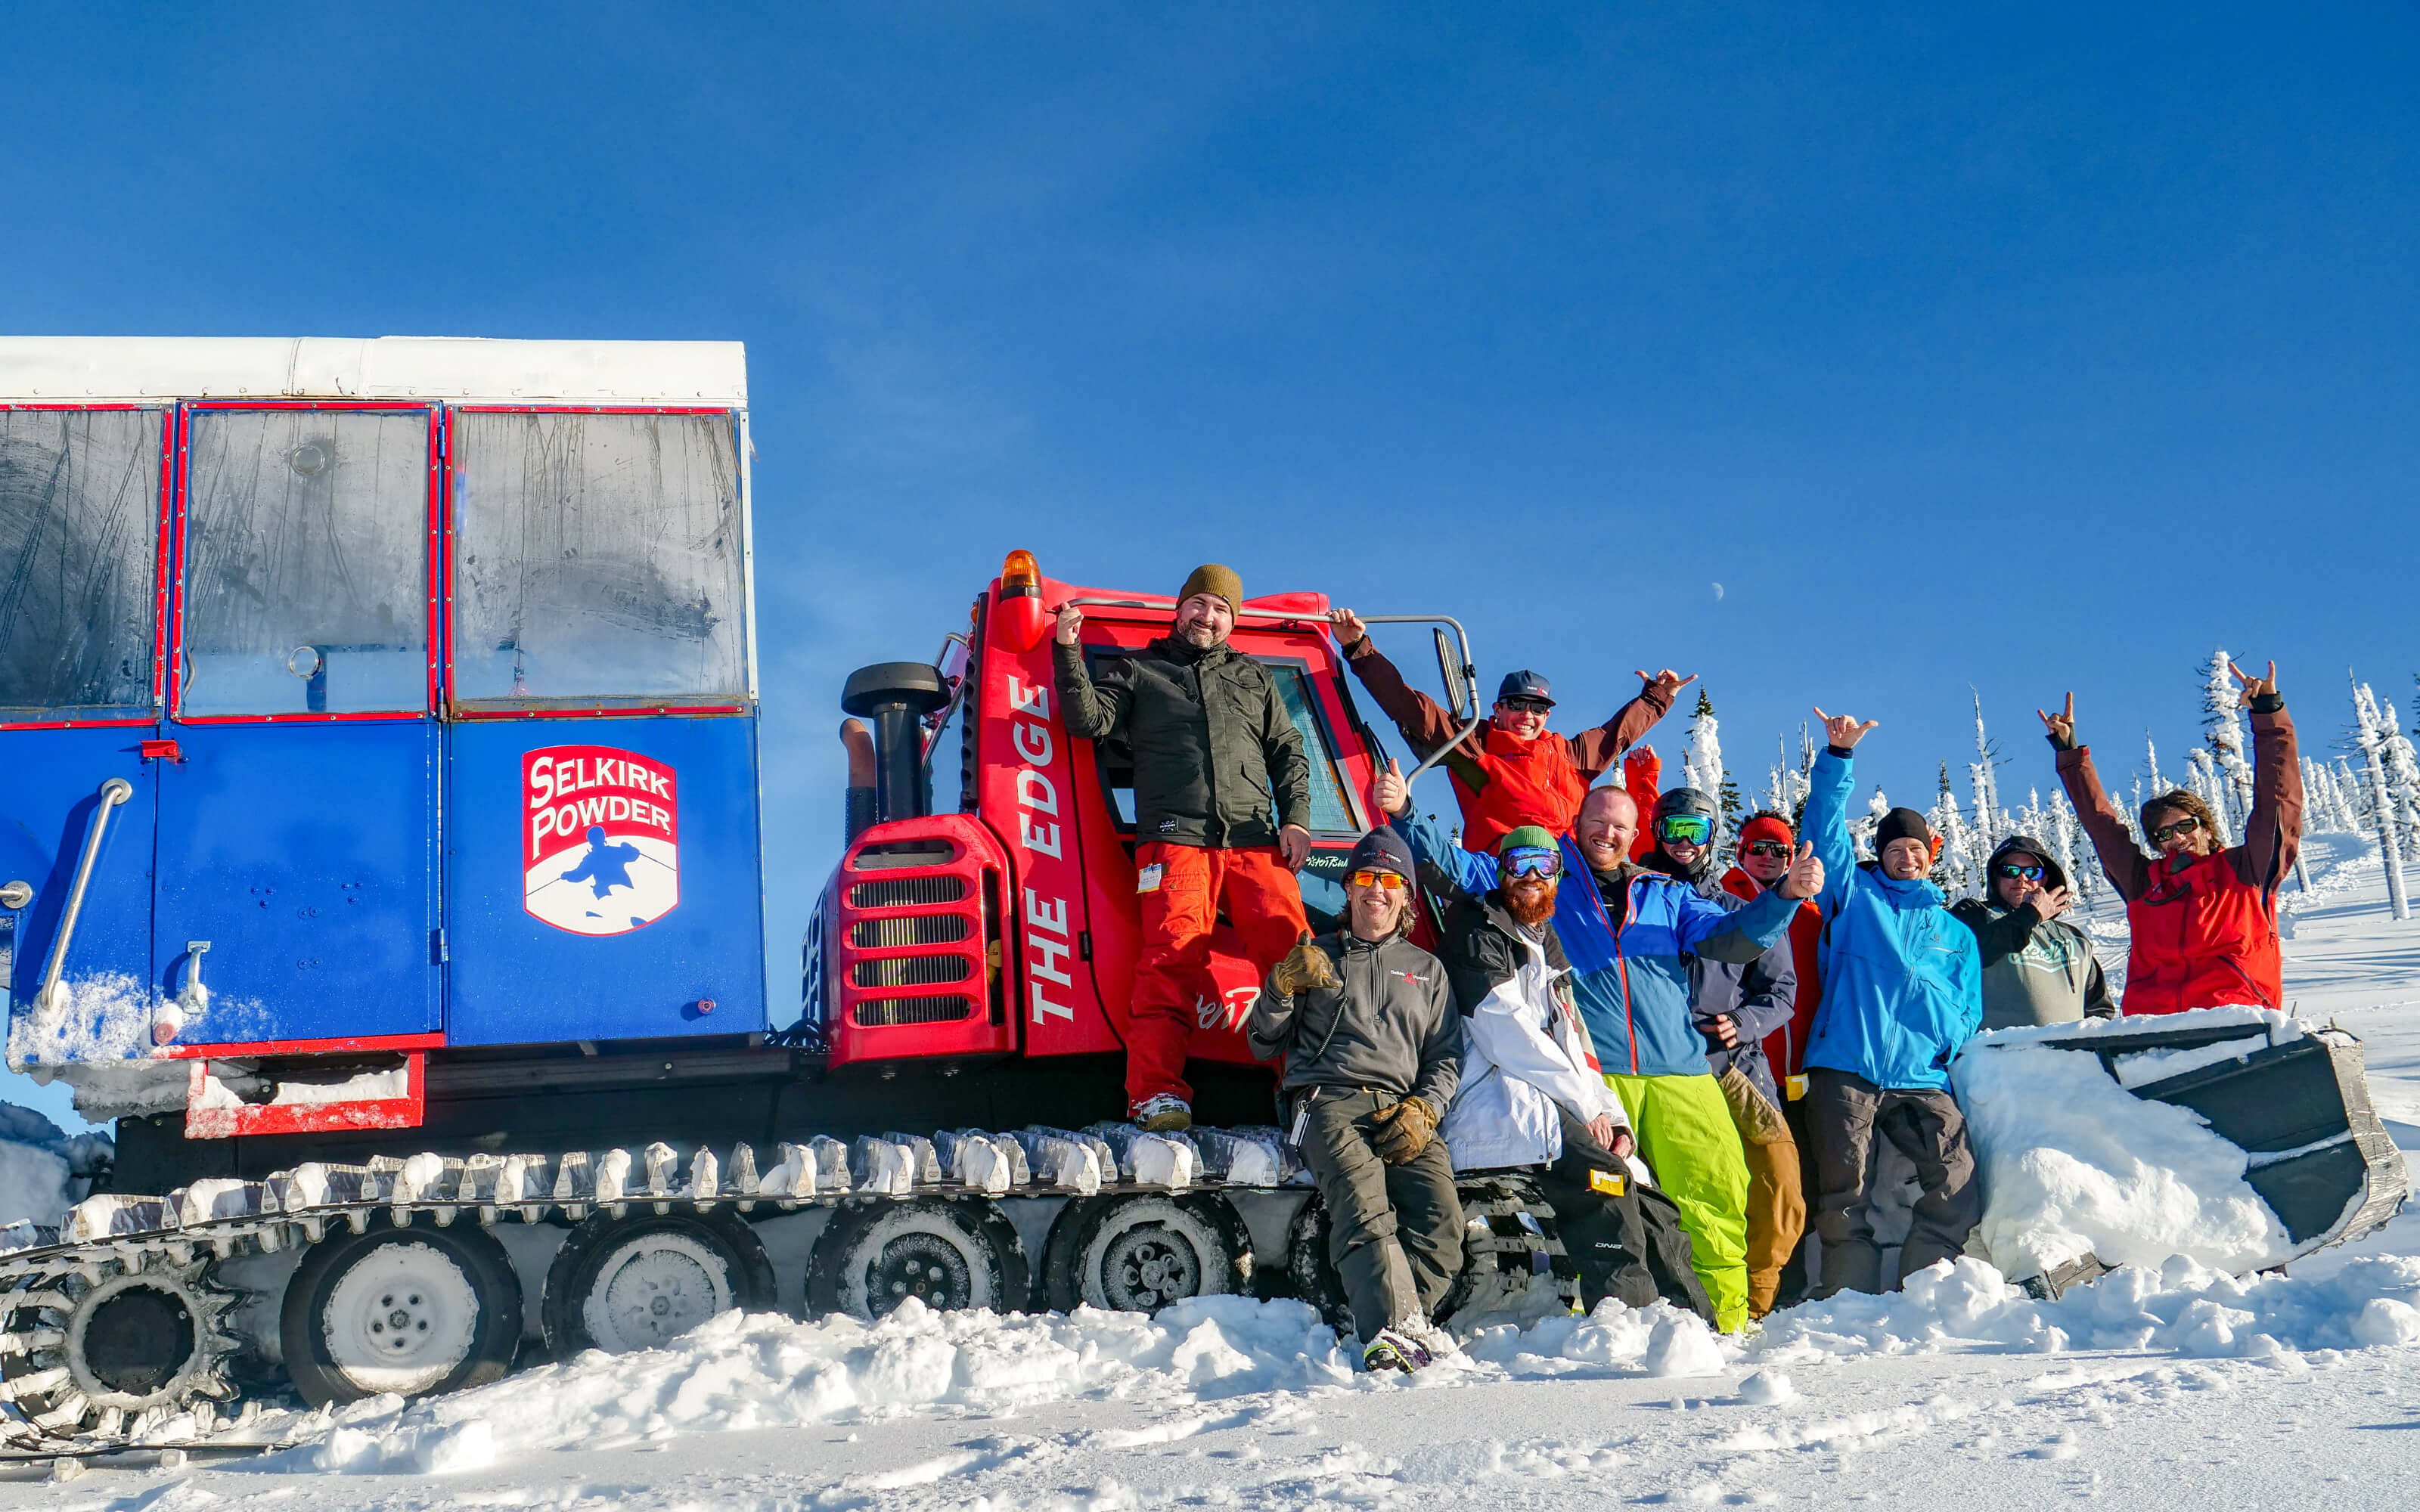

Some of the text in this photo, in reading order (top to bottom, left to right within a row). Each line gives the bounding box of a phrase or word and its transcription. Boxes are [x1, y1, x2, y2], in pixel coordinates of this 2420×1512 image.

[530, 756, 672, 809] SELKIRK
[532, 796, 672, 861] POWDER
[1007, 674, 1074, 1026] THE EDGE
